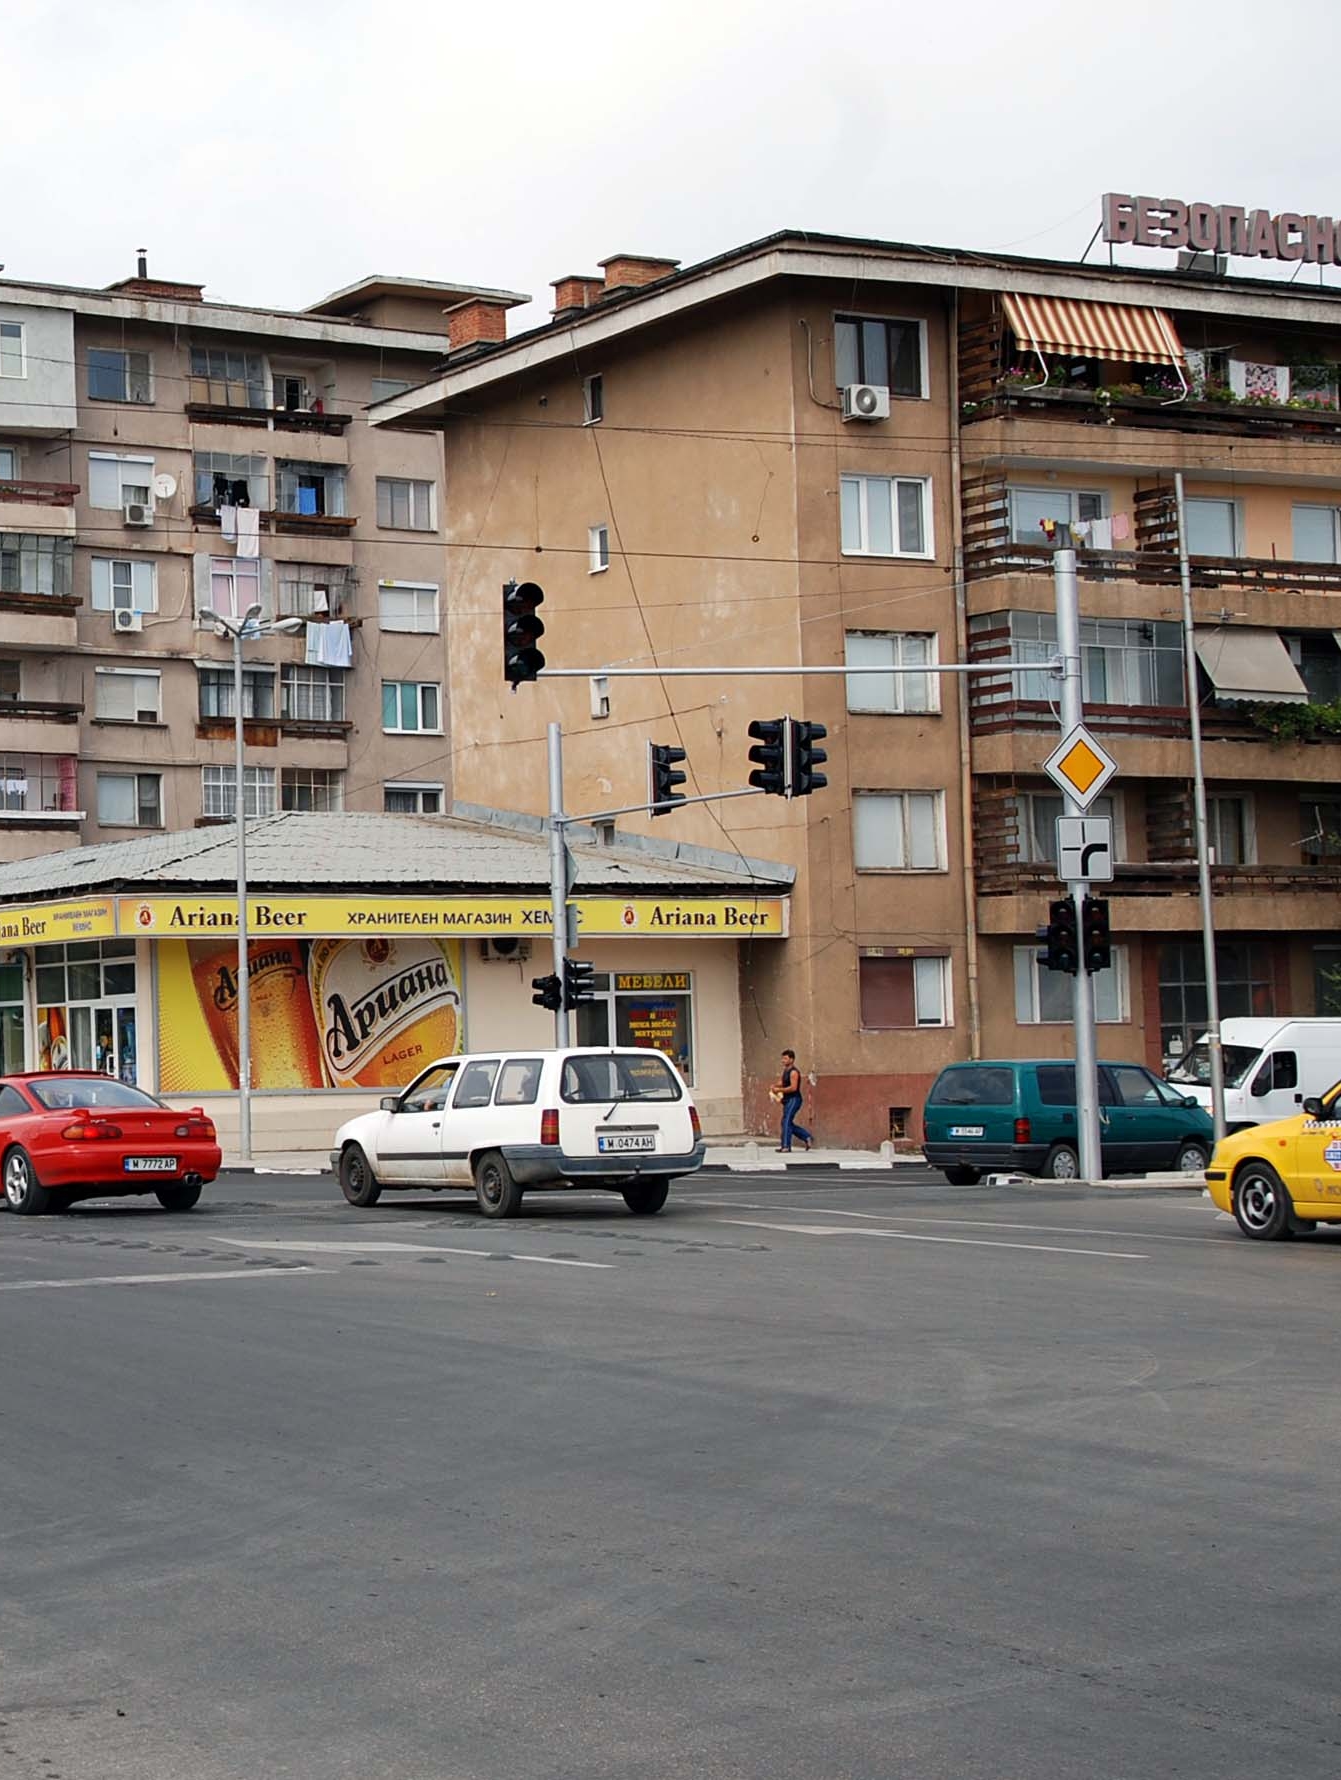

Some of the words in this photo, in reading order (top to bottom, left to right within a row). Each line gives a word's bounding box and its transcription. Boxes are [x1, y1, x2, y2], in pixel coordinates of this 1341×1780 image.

[255, 905, 307, 926] Beer
[347, 912, 438, 925] ХРАНИТЕЛЕН
[443, 912, 512, 925] МАГАЗИН
[650, 906, 717, 926] Ariana
[724, 907, 769, 926] Beer
[22, 916, 47, 936] Beer
[214, 951, 292, 1007] Аиана
[619, 975, 686, 988] МЕБЕЛИ
[327, 963, 449, 1058] Ариана
[382, 1044, 424, 1065] LAGER
[618, 1137, 640, 1148] 0474
[142, 1159, 163, 1168] 7772
